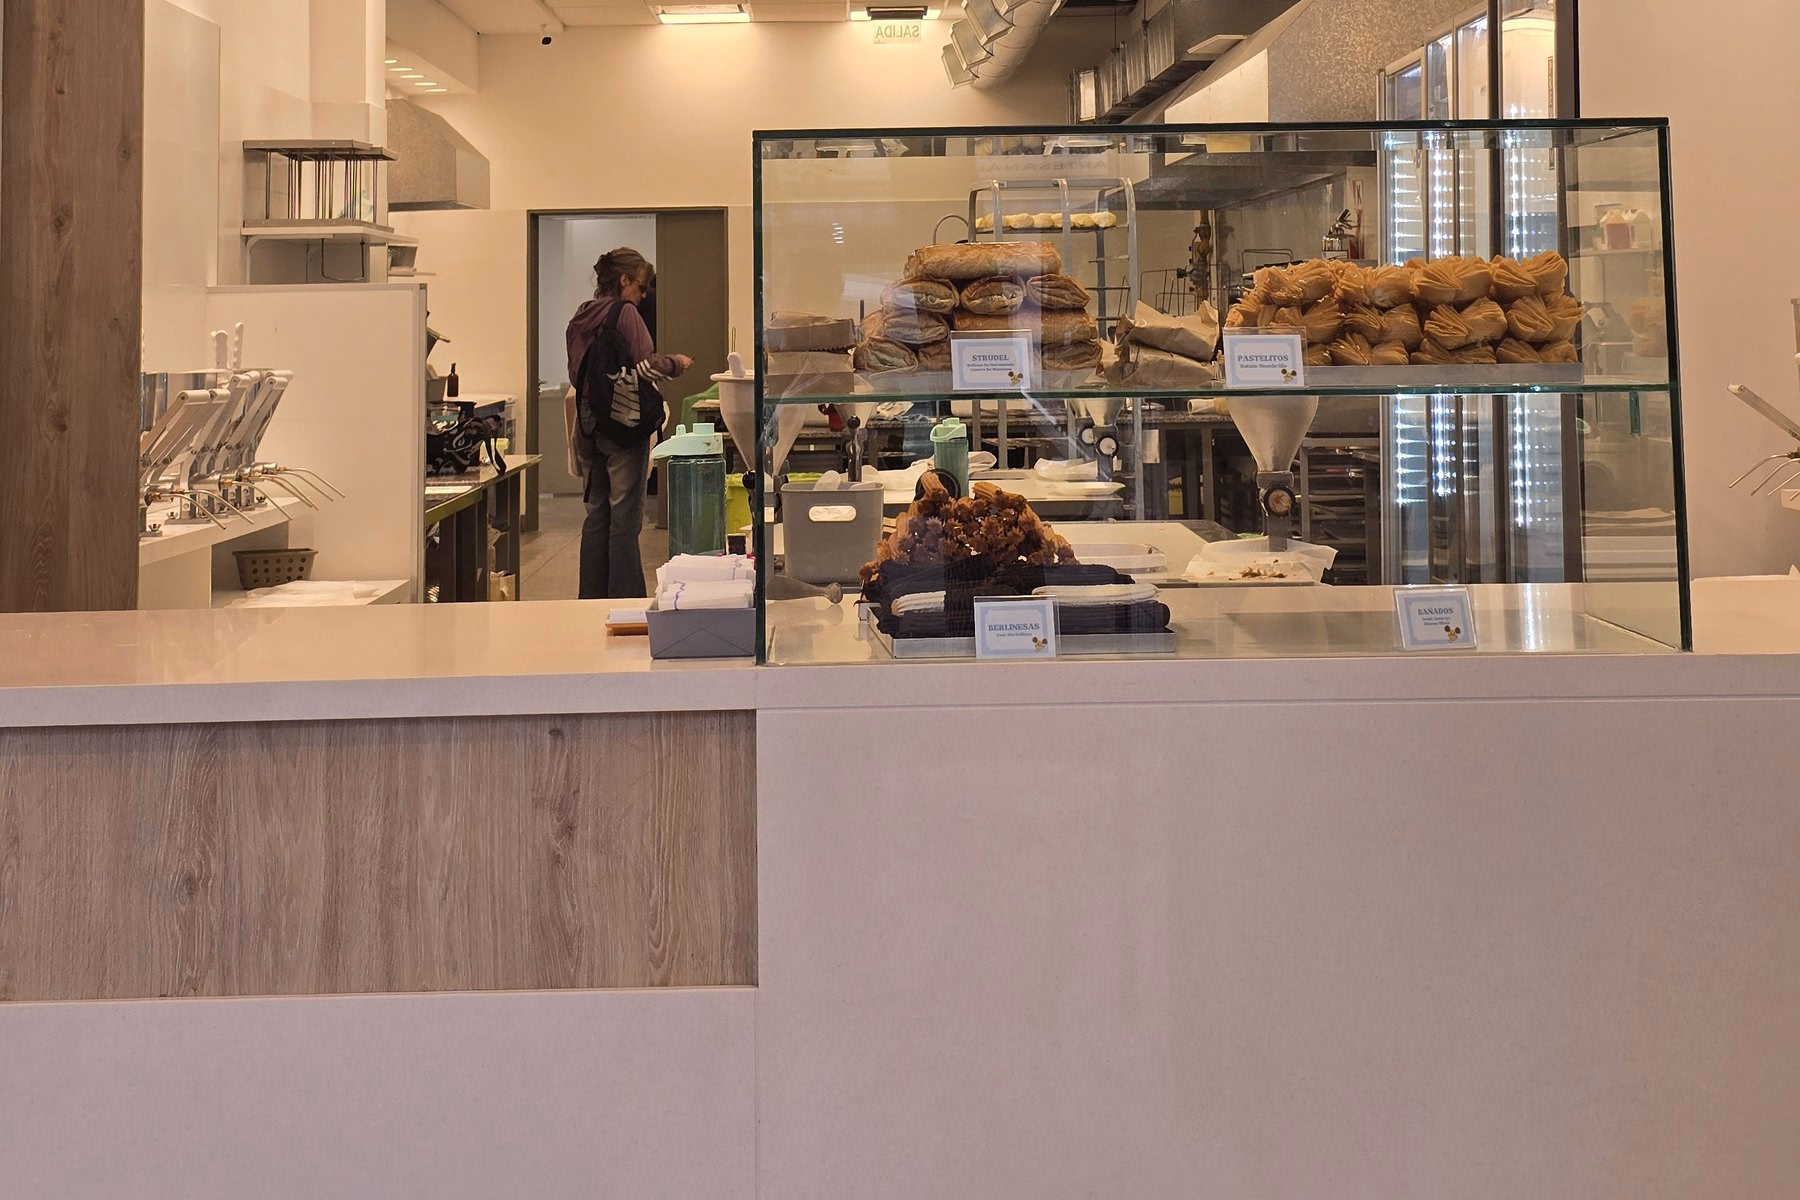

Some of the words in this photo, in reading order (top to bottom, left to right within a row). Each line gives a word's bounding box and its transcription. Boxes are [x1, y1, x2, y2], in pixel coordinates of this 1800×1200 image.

[972, 354, 1010, 362] STRUDEL
[1237, 354, 1289, 362] PASTELITOS
[1417, 606, 1454, 616] BAÑADOS
[988, 623, 1040, 632] BERLINESAS
